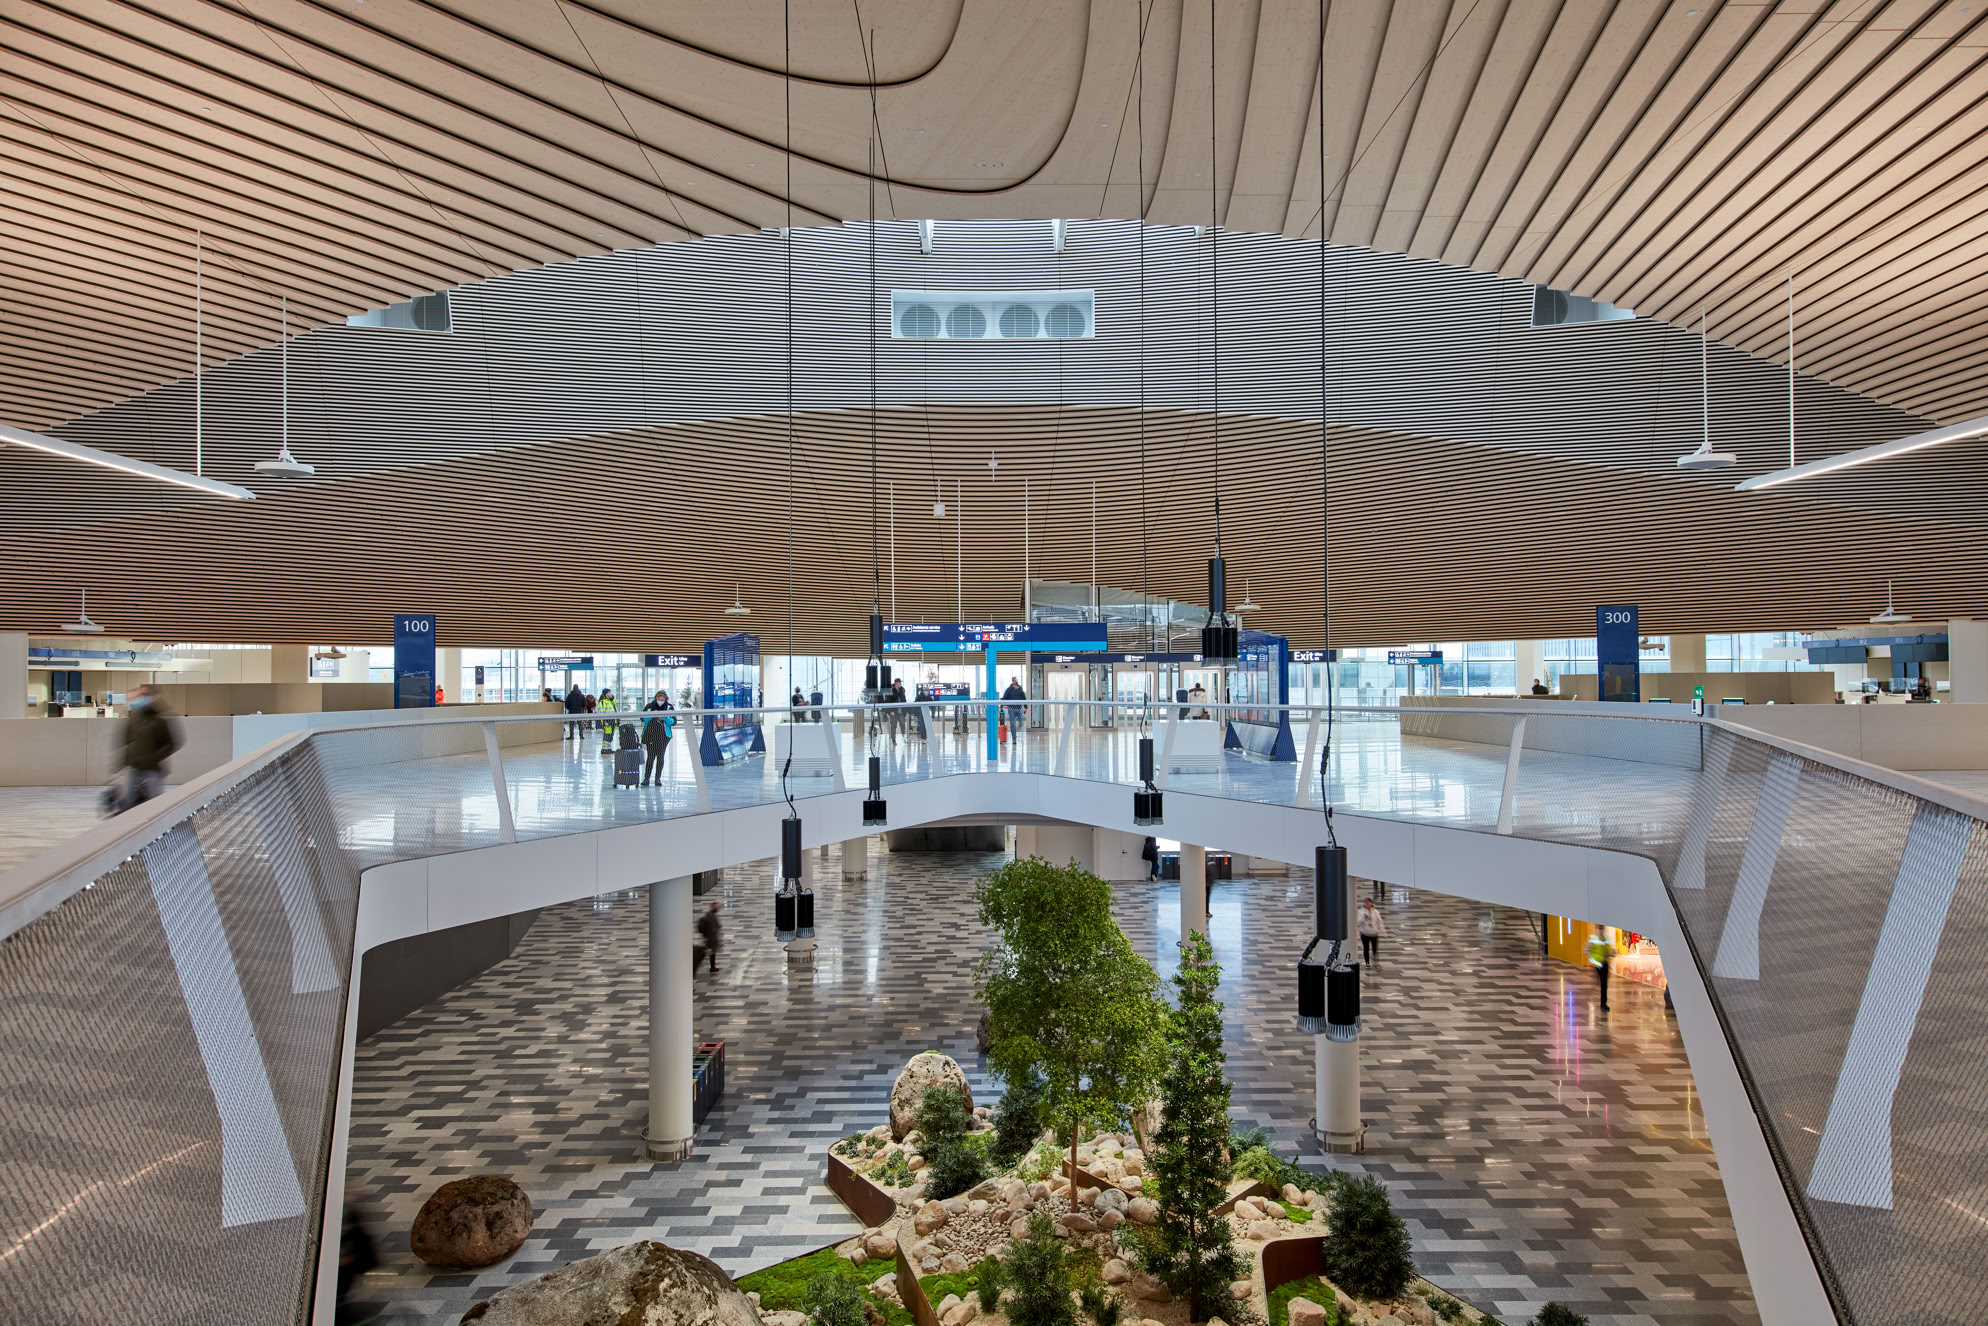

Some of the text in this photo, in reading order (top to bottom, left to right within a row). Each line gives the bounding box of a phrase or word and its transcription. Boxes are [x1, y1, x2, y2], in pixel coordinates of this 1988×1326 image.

[1604, 612, 1631, 624] 300
[403, 620, 429, 632] 100
[658, 655, 679, 666] Exit
[1294, 651, 1314, 661] Exit
